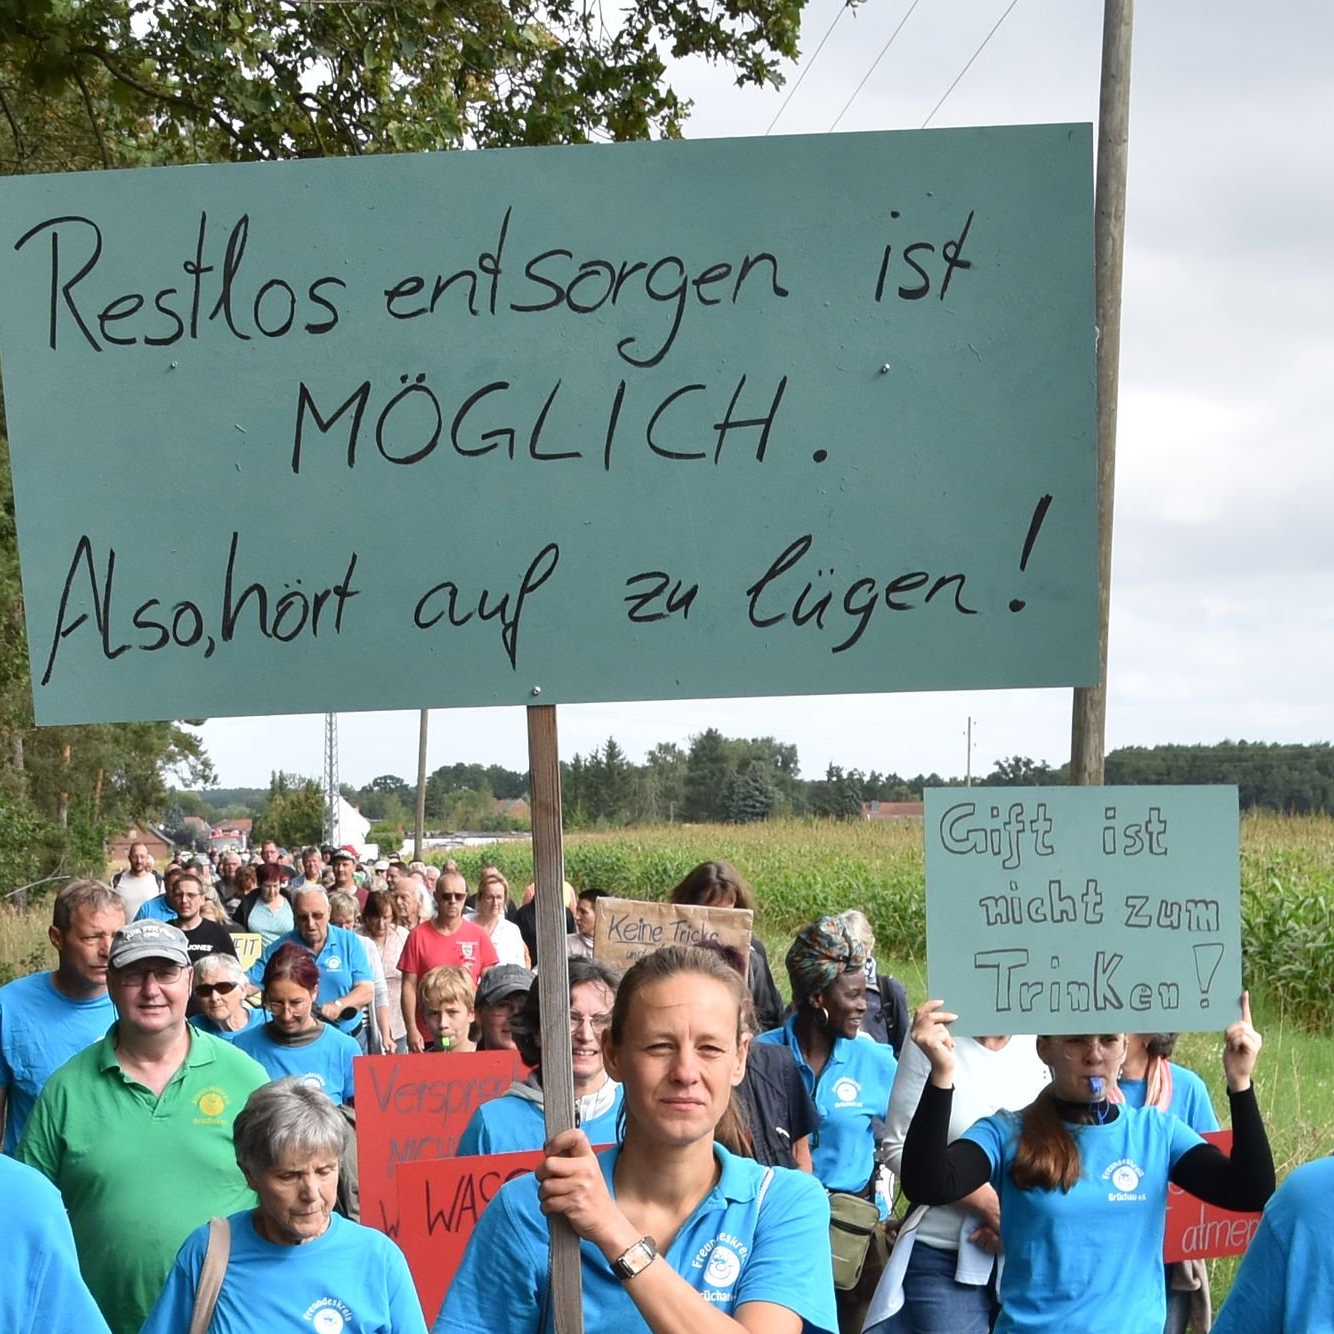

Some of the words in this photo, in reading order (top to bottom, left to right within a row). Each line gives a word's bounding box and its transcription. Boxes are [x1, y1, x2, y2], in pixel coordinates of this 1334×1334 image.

[14, 210, 344, 352] Restlos
[385, 205, 790, 368] entsorgen
[874, 210, 976, 303] ist
[290, 373, 829, 472] MÖGLICH.
[414, 541, 560, 670] auf
[625, 569, 693, 625] zu
[745, 493, 1054, 653] lügen!
[940, 803, 1054, 870] Gift
[1103, 806, 1168, 856] ist
[608, 914, 663, 943] Keine
[979, 879, 1103, 926] nicht
[1124, 896, 1219, 932] zum
